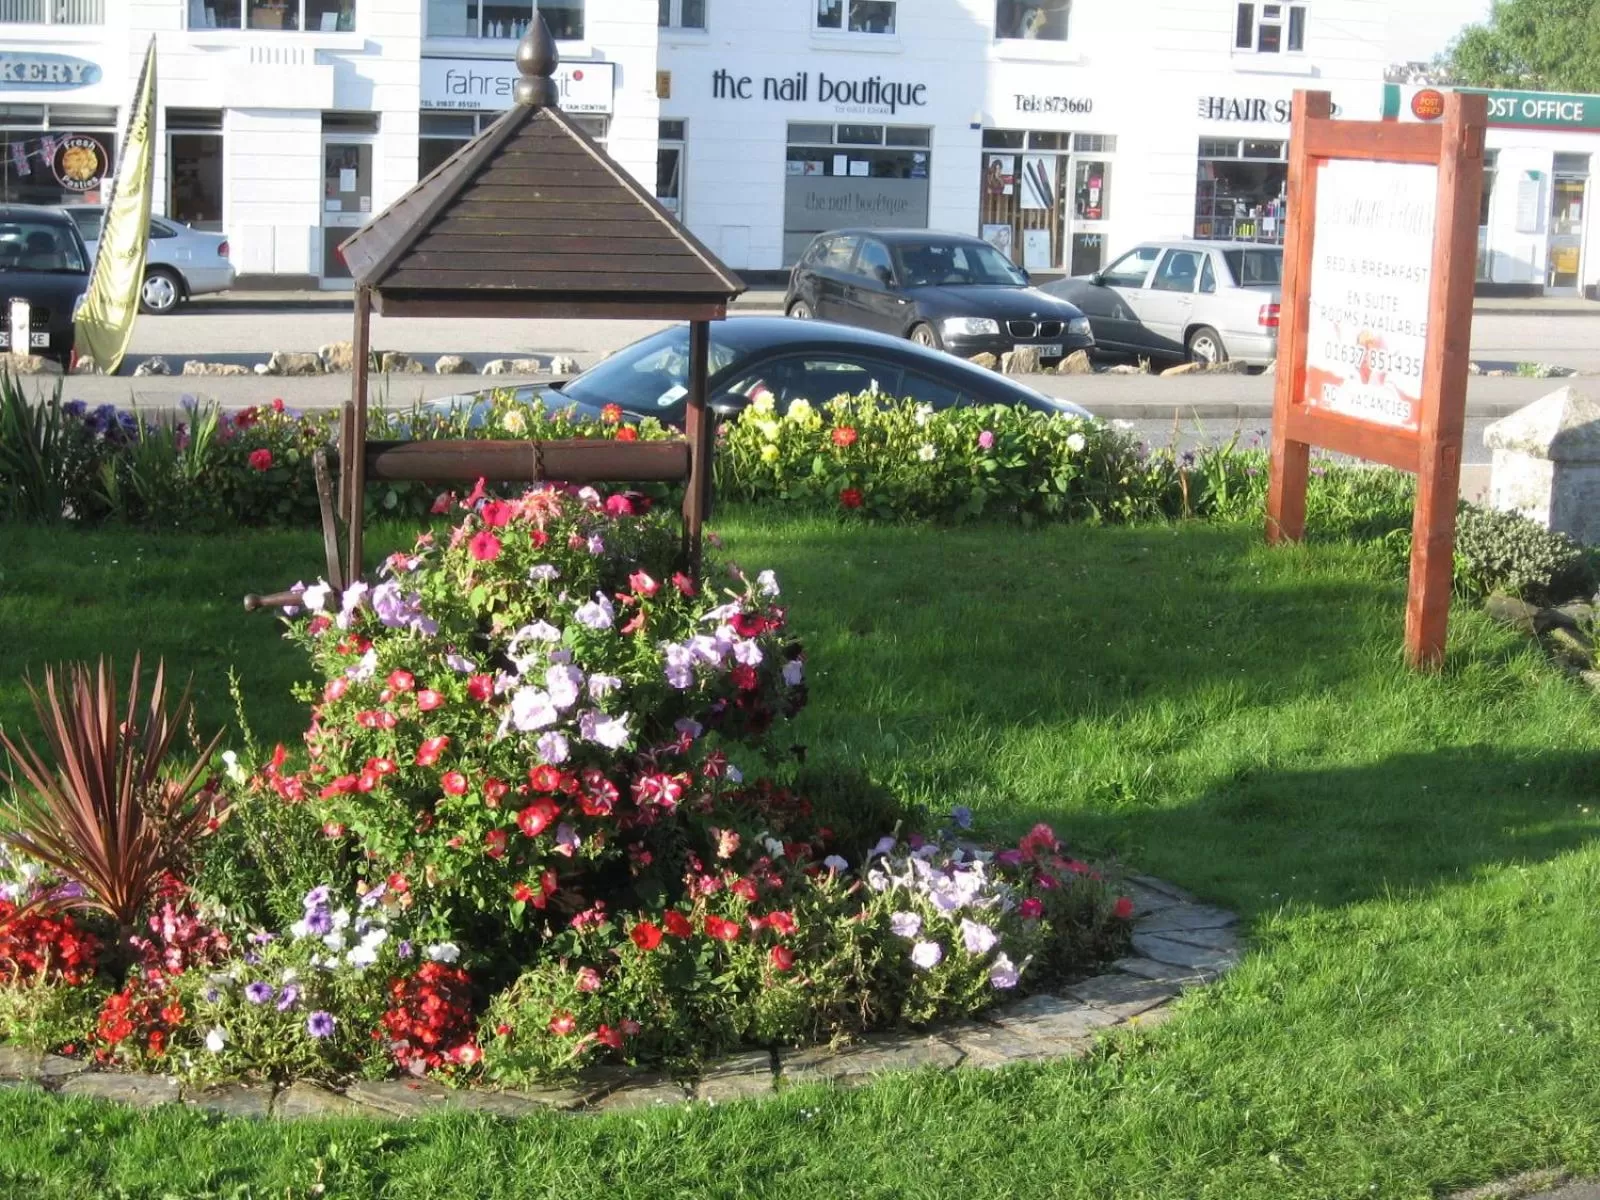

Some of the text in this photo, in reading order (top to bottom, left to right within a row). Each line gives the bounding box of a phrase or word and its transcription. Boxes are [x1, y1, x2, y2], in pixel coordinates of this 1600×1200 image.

[712, 68, 927, 115] the nail boutique
[1012, 93, 1093, 113] Tel: 873660
[1420, 96, 1439, 106] POST
[1208, 96, 1267, 121] HAIR
[1416, 106, 1441, 115] OFFICE
[1487, 98, 1584, 121] OST OFFICE
[63, 139, 97, 150] Fresh
[62, 175, 98, 189] Pasties
[1325, 255, 1346, 272] BED
[1361, 259, 1429, 283] BREAKFAST
[1347, 290, 1400, 313] EN SUITE
[1320, 305, 1428, 339] ROOMS AVAILABLE
[1324, 340, 1421, 377] 01637 851435
